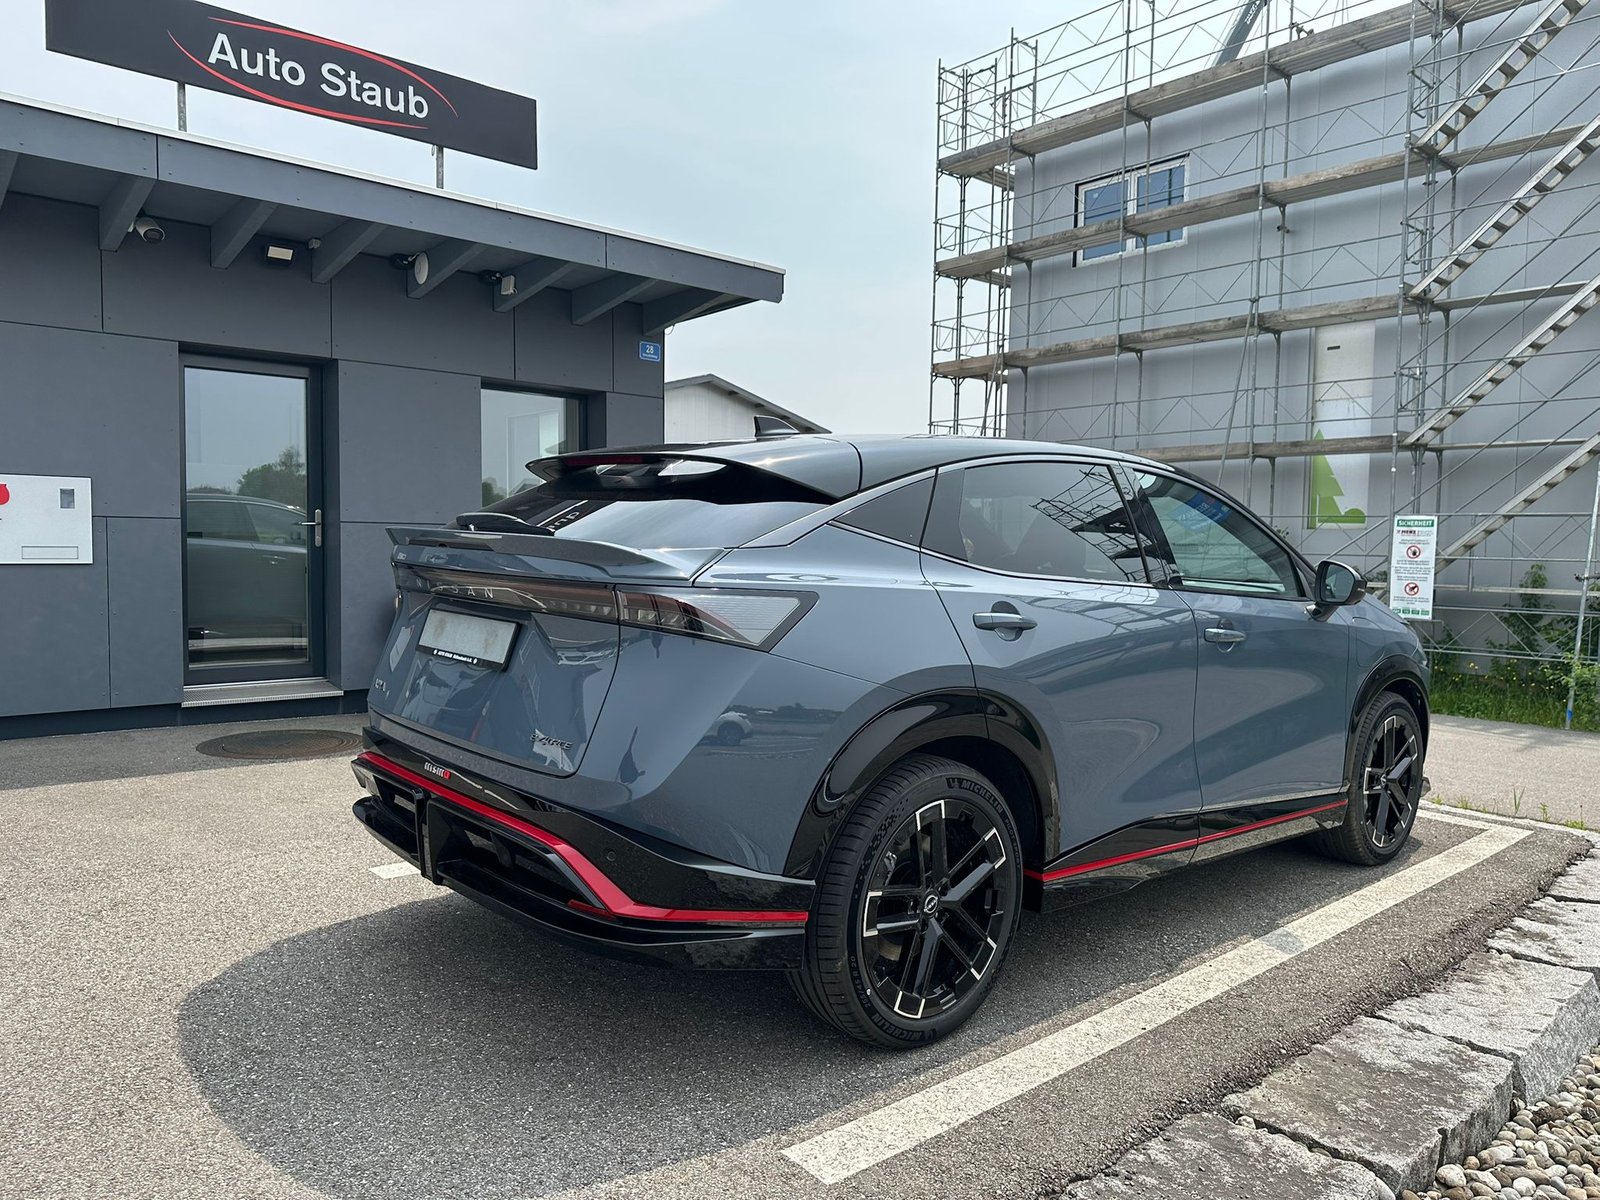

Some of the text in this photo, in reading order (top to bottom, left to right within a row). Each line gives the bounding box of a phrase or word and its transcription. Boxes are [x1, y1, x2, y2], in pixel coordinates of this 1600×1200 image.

[208, 32, 429, 119] Auto Staub
[645, 344, 654, 354] 28
[416, 578, 494, 598] NISSAN
[961, 780, 1004, 814] MICHELIN
[1005, 819, 1016, 840] PILOT
[872, 1013, 922, 1040] MICHELIN
